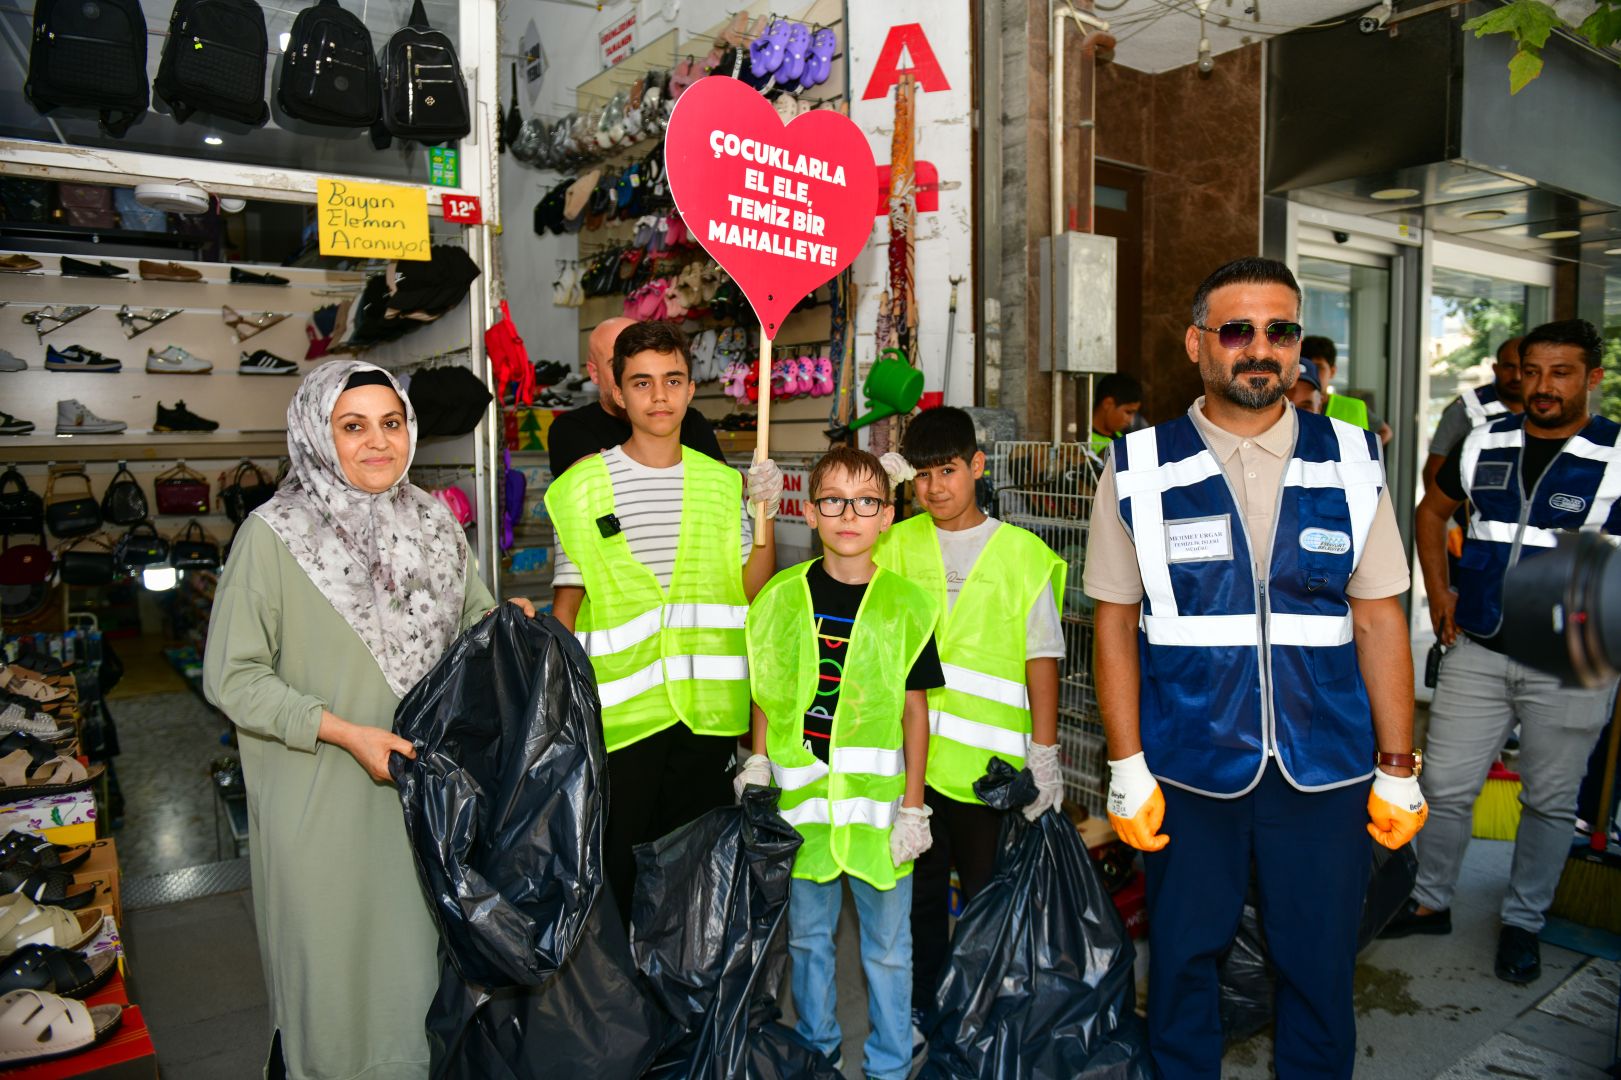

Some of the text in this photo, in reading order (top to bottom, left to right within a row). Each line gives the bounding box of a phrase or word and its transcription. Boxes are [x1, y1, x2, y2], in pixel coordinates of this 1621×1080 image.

[709, 130, 847, 187] ÇOCUKLARLA
[328, 182, 395, 219] Bayan
[745, 167, 813, 208] EL ELE,
[326, 208, 406, 229] Eleman
[449, 200, 476, 217] 12A
[728, 194, 825, 237] TEMİZ BİR
[708, 219, 838, 267] MAHALLEYE!
